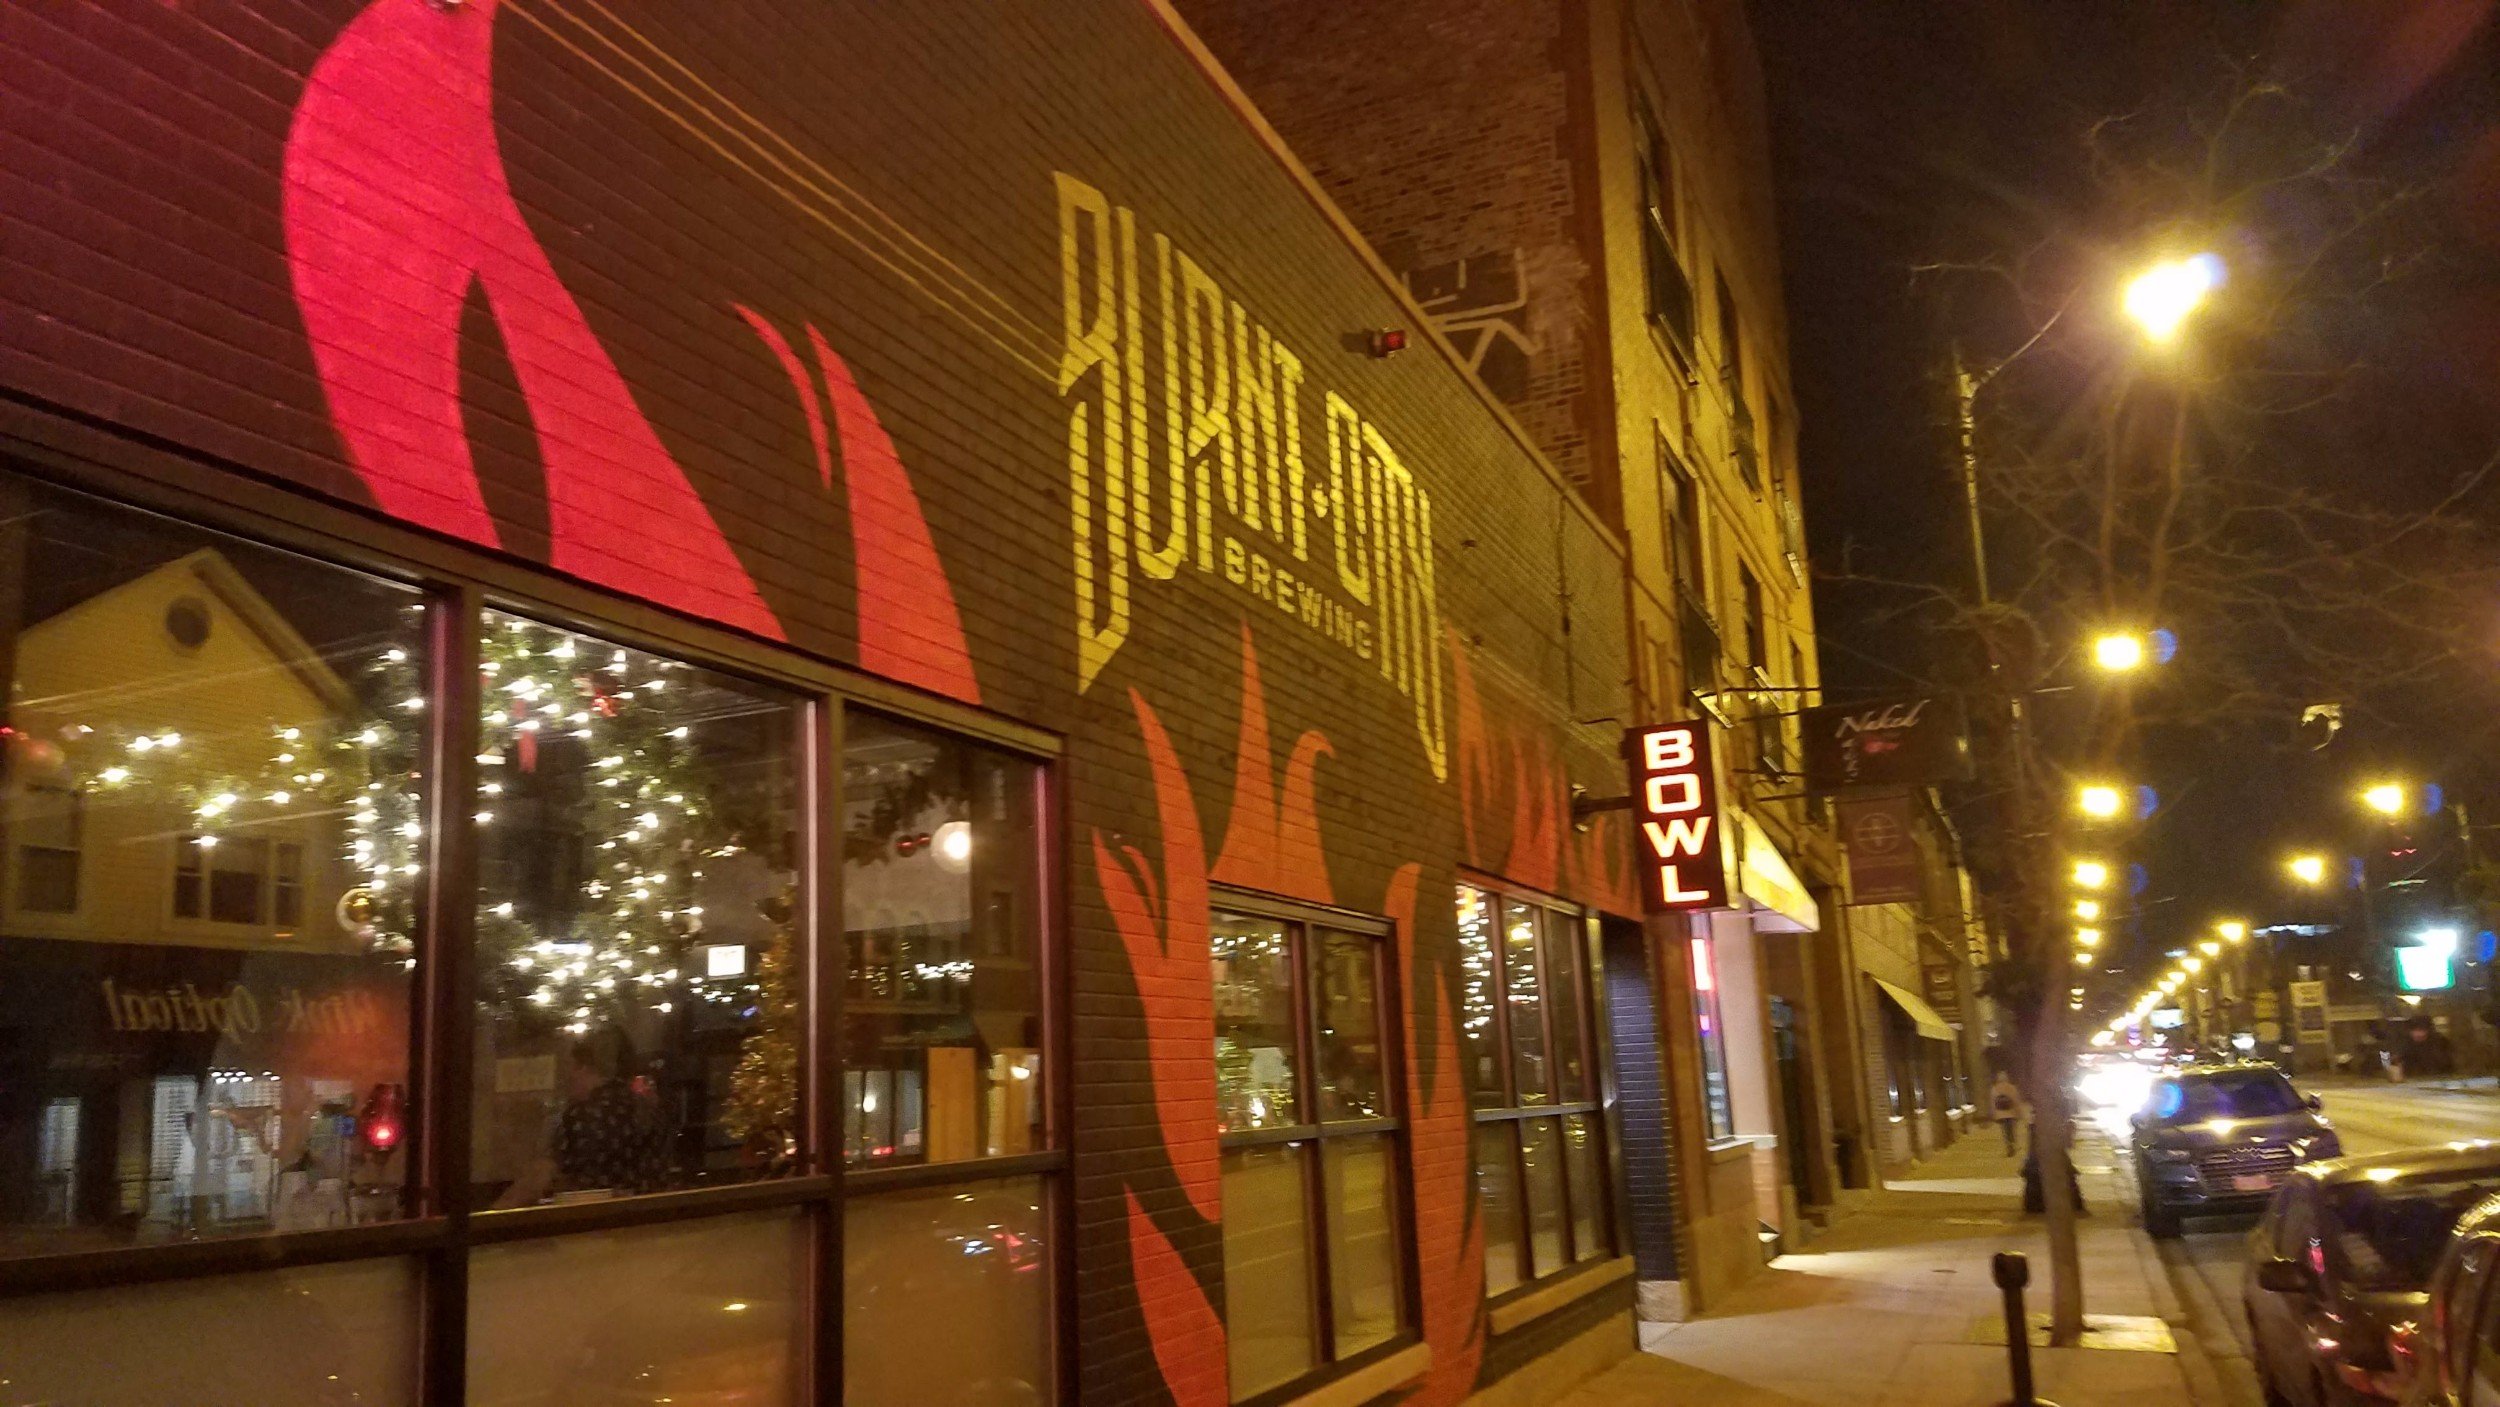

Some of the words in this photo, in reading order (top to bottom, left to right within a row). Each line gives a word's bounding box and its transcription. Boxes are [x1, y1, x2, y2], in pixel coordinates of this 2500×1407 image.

[1055, 171, 1308, 695] BURNT
[1225, 537, 1371, 659] BREWING
[1643, 729, 1711, 903] BOWL
